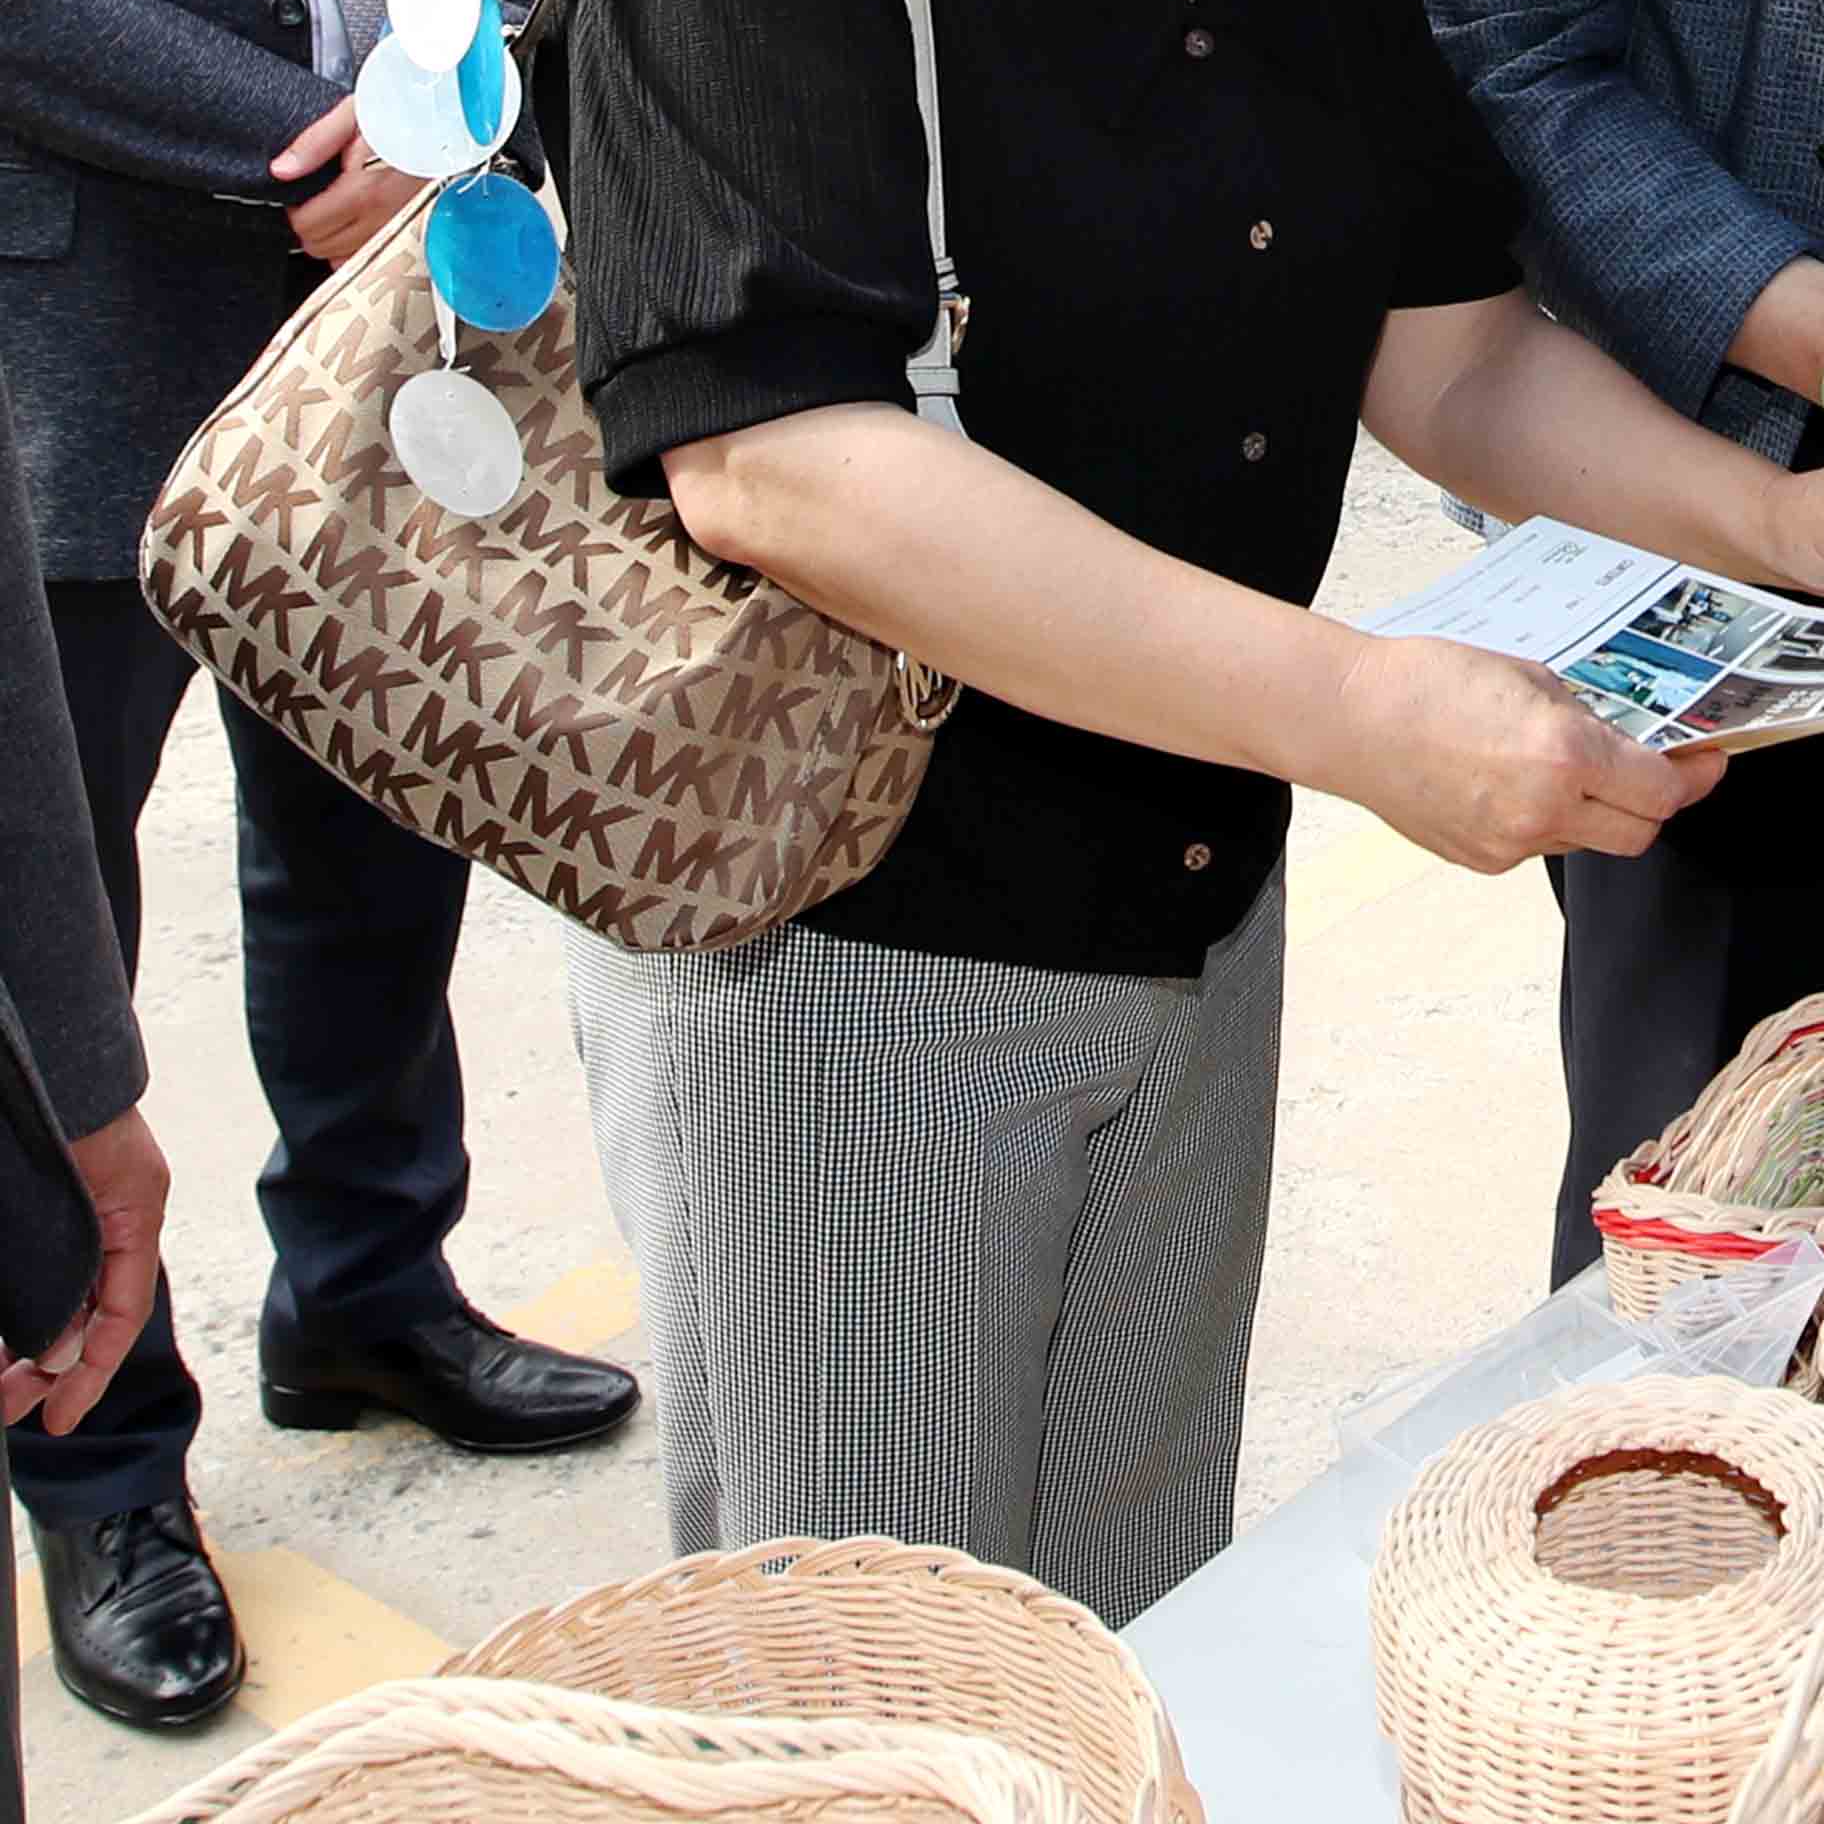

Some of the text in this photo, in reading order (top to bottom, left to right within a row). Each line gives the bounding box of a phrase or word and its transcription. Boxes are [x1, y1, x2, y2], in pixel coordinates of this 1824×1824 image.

[220, 435, 320, 551] MK
[308, 410, 410, 529] MK
[213, 535, 316, 653] MK
[302, 515, 418, 631] MK
[397, 497, 518, 601] MK
[503, 493, 620, 590] MK
[403, 591, 514, 705] MK
[494, 572, 618, 680] MK
[603, 563, 724, 657] MK
[234, 640, 325, 749] MK
[305, 617, 420, 735] MK
[496, 665, 619, 773] MK
[713, 676, 819, 747] MK
[331, 721, 430, 823] MK
[404, 693, 516, 803] MK
[609, 730, 736, 814] MK
[437, 794, 543, 891] MK
[512, 767, 643, 867] MK
[634, 821, 758, 895] MK
[548, 864, 666, 944] MK
